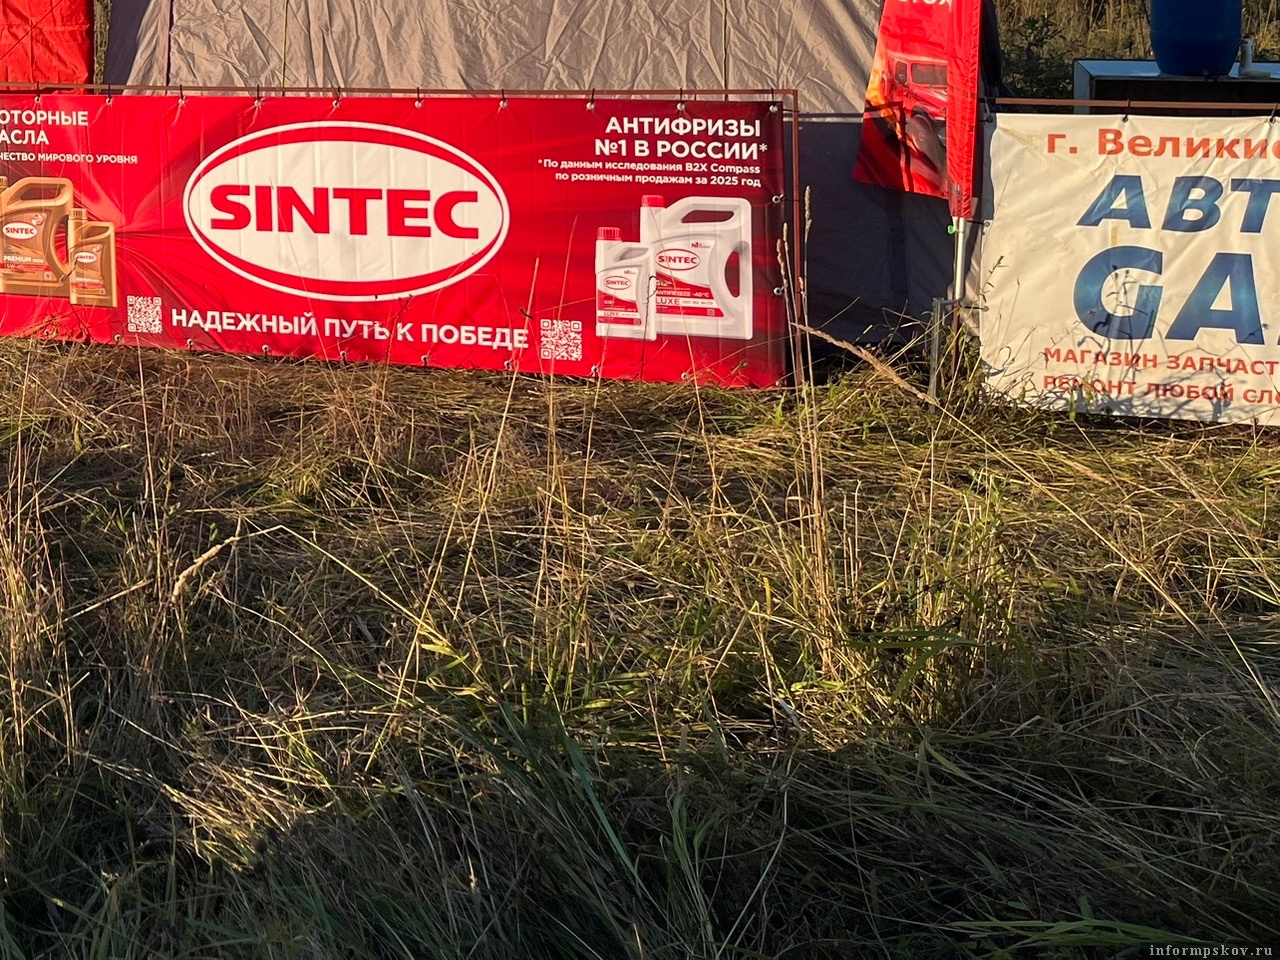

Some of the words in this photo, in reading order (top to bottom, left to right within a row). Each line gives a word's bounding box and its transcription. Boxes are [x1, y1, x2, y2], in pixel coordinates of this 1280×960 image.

[604, 116, 761, 137] АНТИФРИЗЫ
[594, 138, 627, 157] №1
[634, 140, 650, 158] В
[1047, 133, 1078, 154] г.
[37, 152, 94, 163] МИРОВОГО
[96, 154, 138, 164] УРОВНЯ
[560, 159, 601, 170] данным
[605, 161, 683, 172] исследования
[685, 162, 707, 172] B2X
[710, 163, 761, 175] Compass
[555, 172, 569, 181] по
[571, 172, 633, 183] розничным
[635, 174, 693, 186] продажам
[695, 176, 708, 186] за
[710, 175, 739, 186] 2025
[741, 178, 761, 188] год
[209, 183, 480, 240] SINTEC
[5, 227, 35, 235] SINTEC
[3, 255, 32, 263] PREMIUM
[658, 255, 698, 264] SINTEC
[656, 297, 680, 305] LUXE
[1072, 244, 1280, 346] GA
[171, 307, 317, 337] НАДЕЖНЫЙ
[324, 317, 390, 341] ПУТЬ
[397, 322, 414, 342] К
[420, 322, 530, 351] ПОБЕДЕ
[1043, 347, 1158, 369] МАГАЗИН
[1145, 382, 1234, 402] ЛЮБОЙ
[1242, 389, 1280, 405] СЛ
